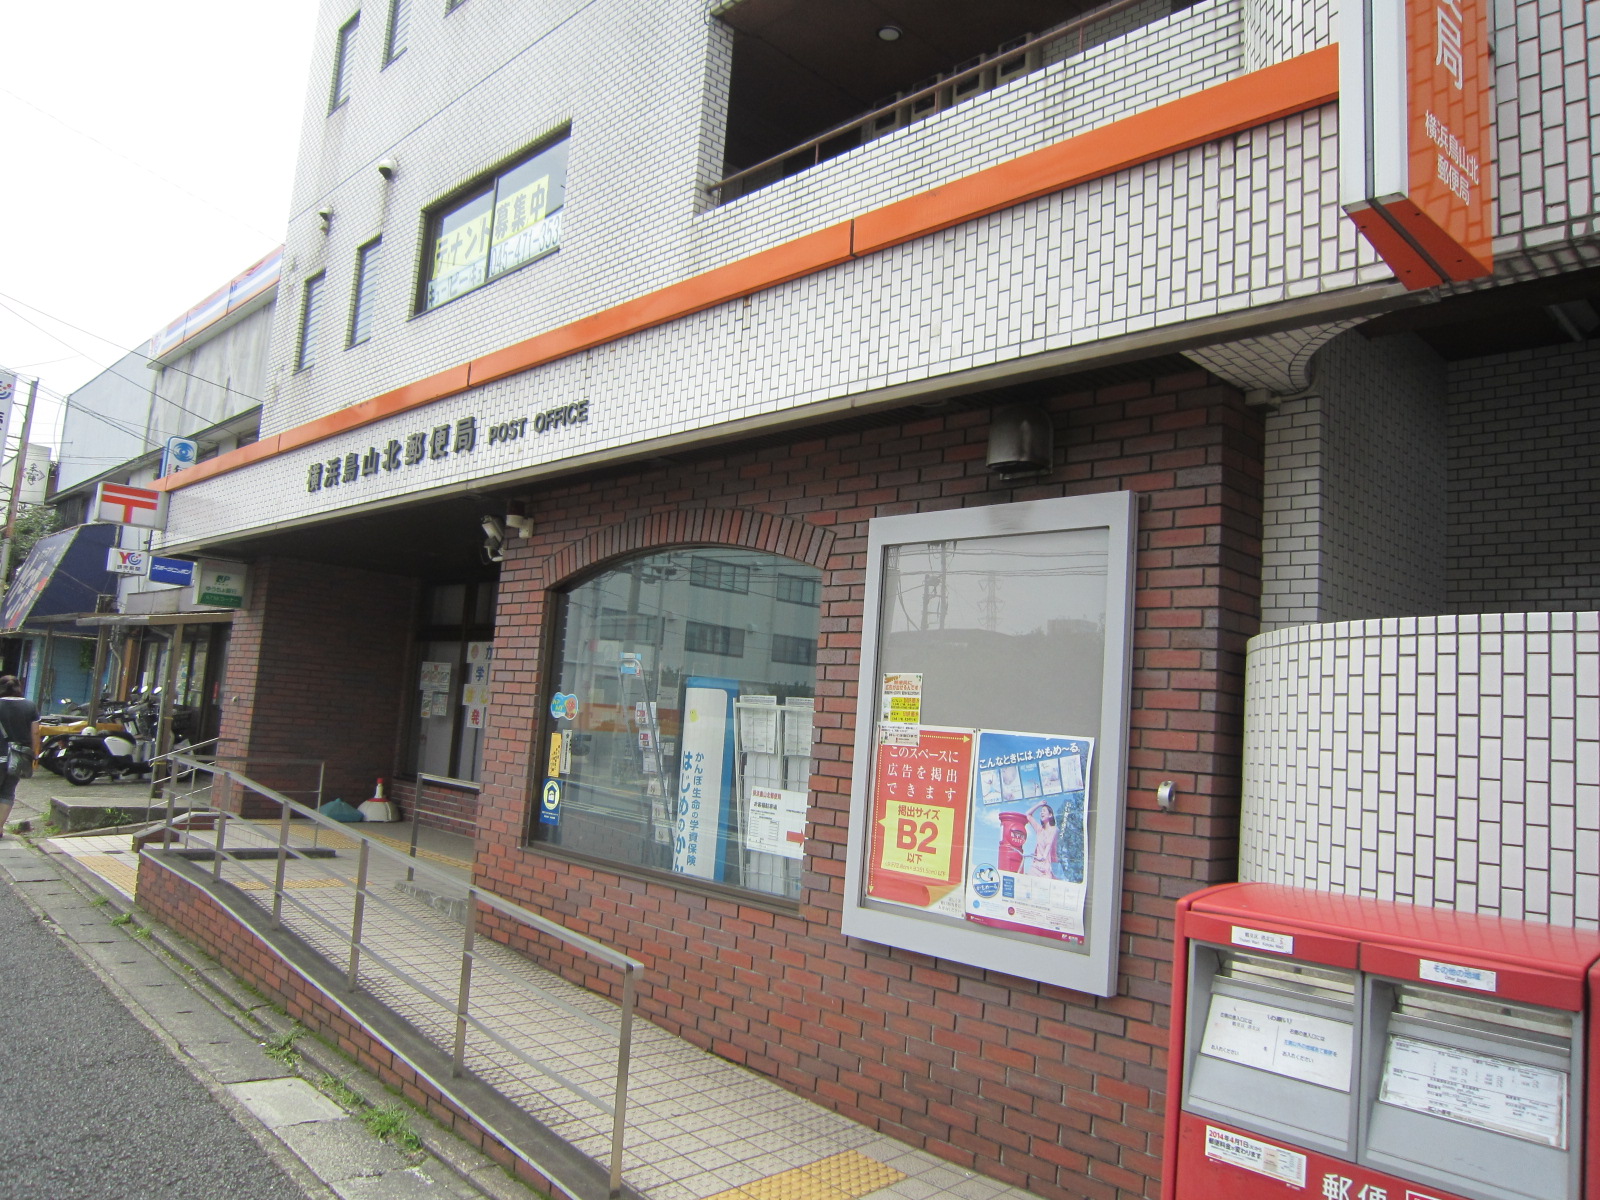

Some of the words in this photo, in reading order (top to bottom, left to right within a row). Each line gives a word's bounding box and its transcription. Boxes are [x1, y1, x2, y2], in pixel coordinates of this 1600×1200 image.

[1436, 0, 1463, 91] 局
[1424, 109, 1479, 186] 横浜鳥山北
[1437, 154, 1470, 206] 郵便局
[306, 416, 477, 493] 横浜鳥山北郵便局
[488, 417, 527, 446] POST
[533, 399, 589, 434] OFFICE
[887, 762, 958, 783] 広告を掲出
[889, 745, 959, 763] このスペースに
[686, 752, 705, 867] かんぽ生命の学資保険
[886, 782, 957, 802] できます
[897, 804, 941, 820] 掲出サイズ
[896, 818, 939, 855] B2
[906, 852, 923, 865] 以下
